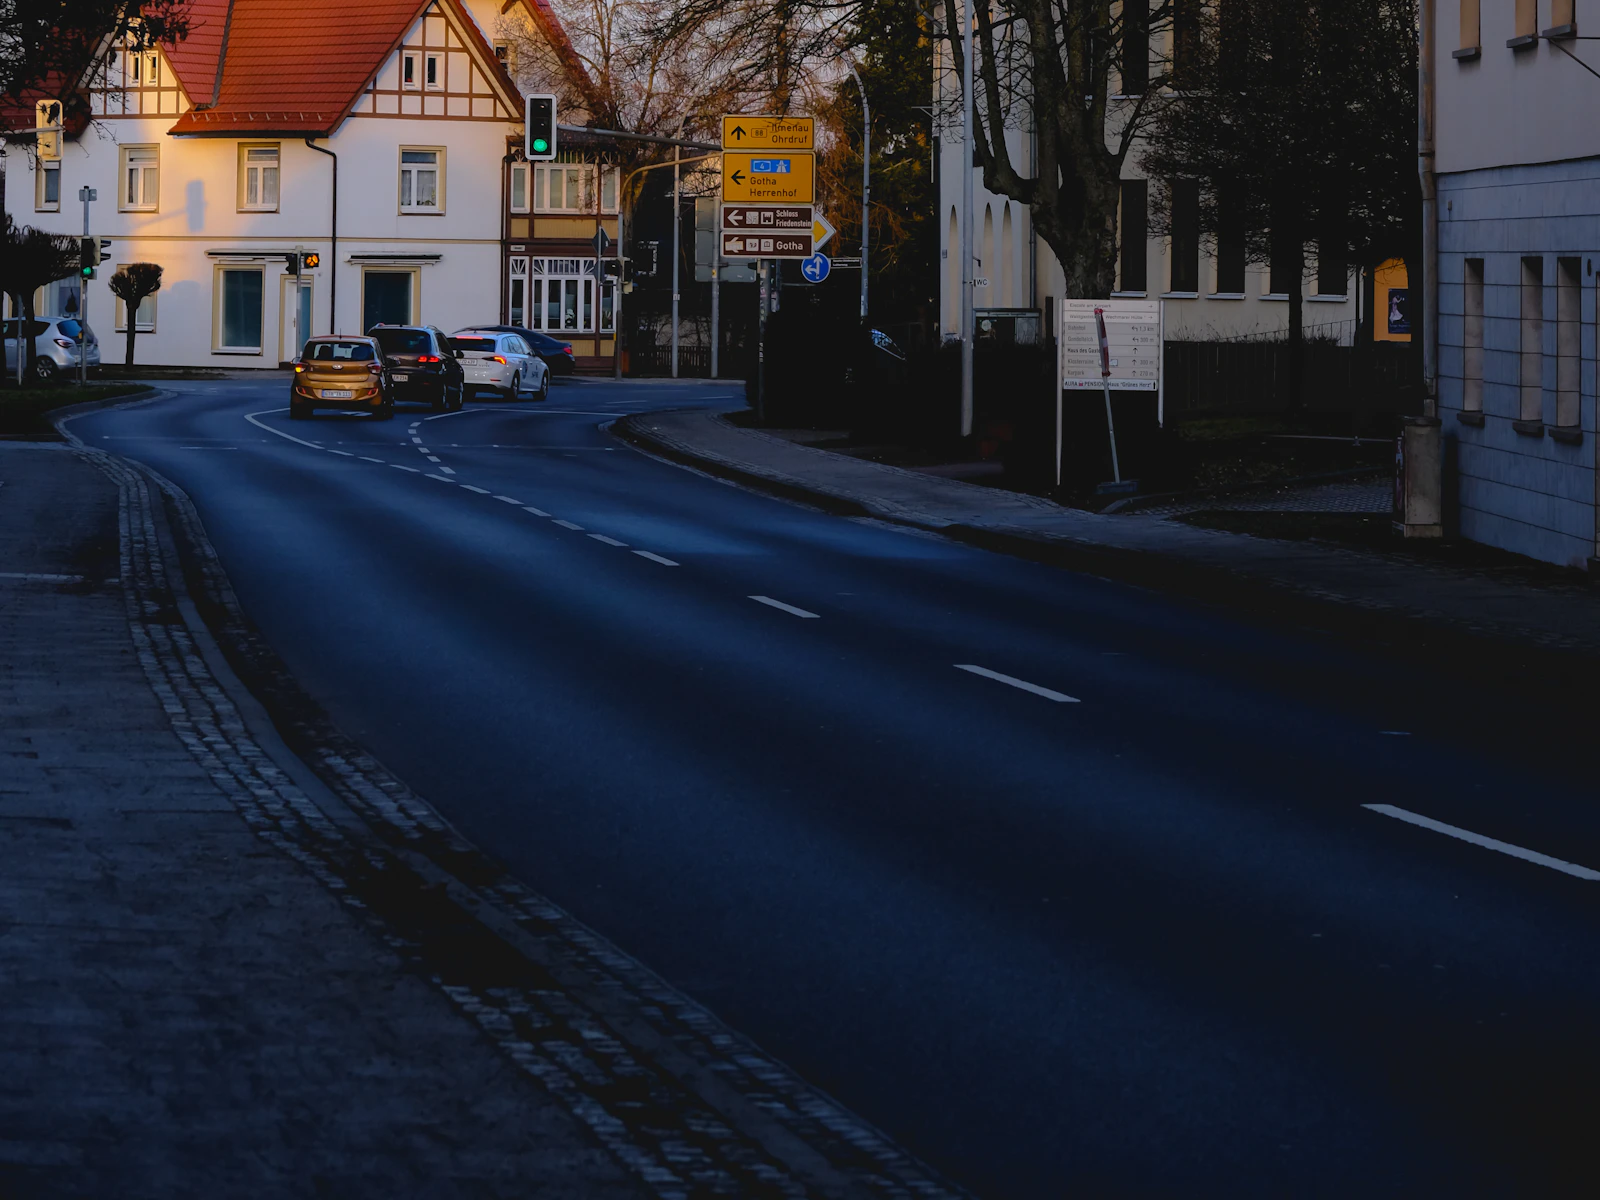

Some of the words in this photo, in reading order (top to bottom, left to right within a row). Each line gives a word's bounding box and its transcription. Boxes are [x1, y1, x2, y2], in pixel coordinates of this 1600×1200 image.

[755, 129, 764, 137] 88
[771, 135, 808, 144] Ohrdruf
[750, 177, 777, 185] Gotha
[749, 188, 797, 197] Herrenhof
[775, 210, 799, 218] Schloss
[775, 220, 812, 228] Friedenstein
[776, 241, 804, 250] Gotha
